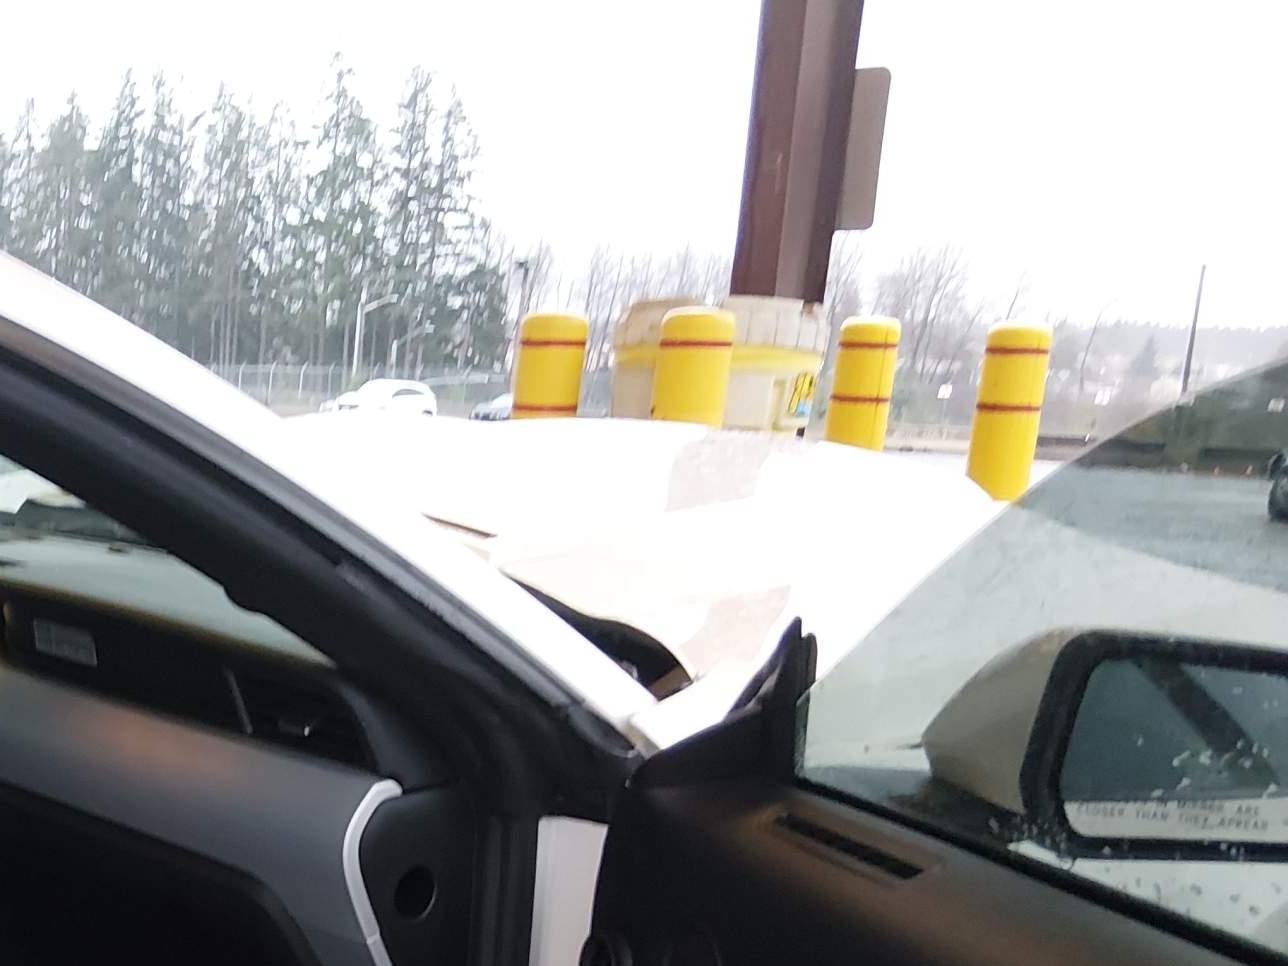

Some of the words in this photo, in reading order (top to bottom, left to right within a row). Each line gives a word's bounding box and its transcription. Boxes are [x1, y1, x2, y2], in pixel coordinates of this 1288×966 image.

[1076, 806, 1124, 817] CLOSER
[1135, 809, 1169, 822] THAN
[1178, 813, 1209, 829] THEY
[1217, 817, 1269, 831] APPEAR
[1235, 804, 1260, 816] ARE
